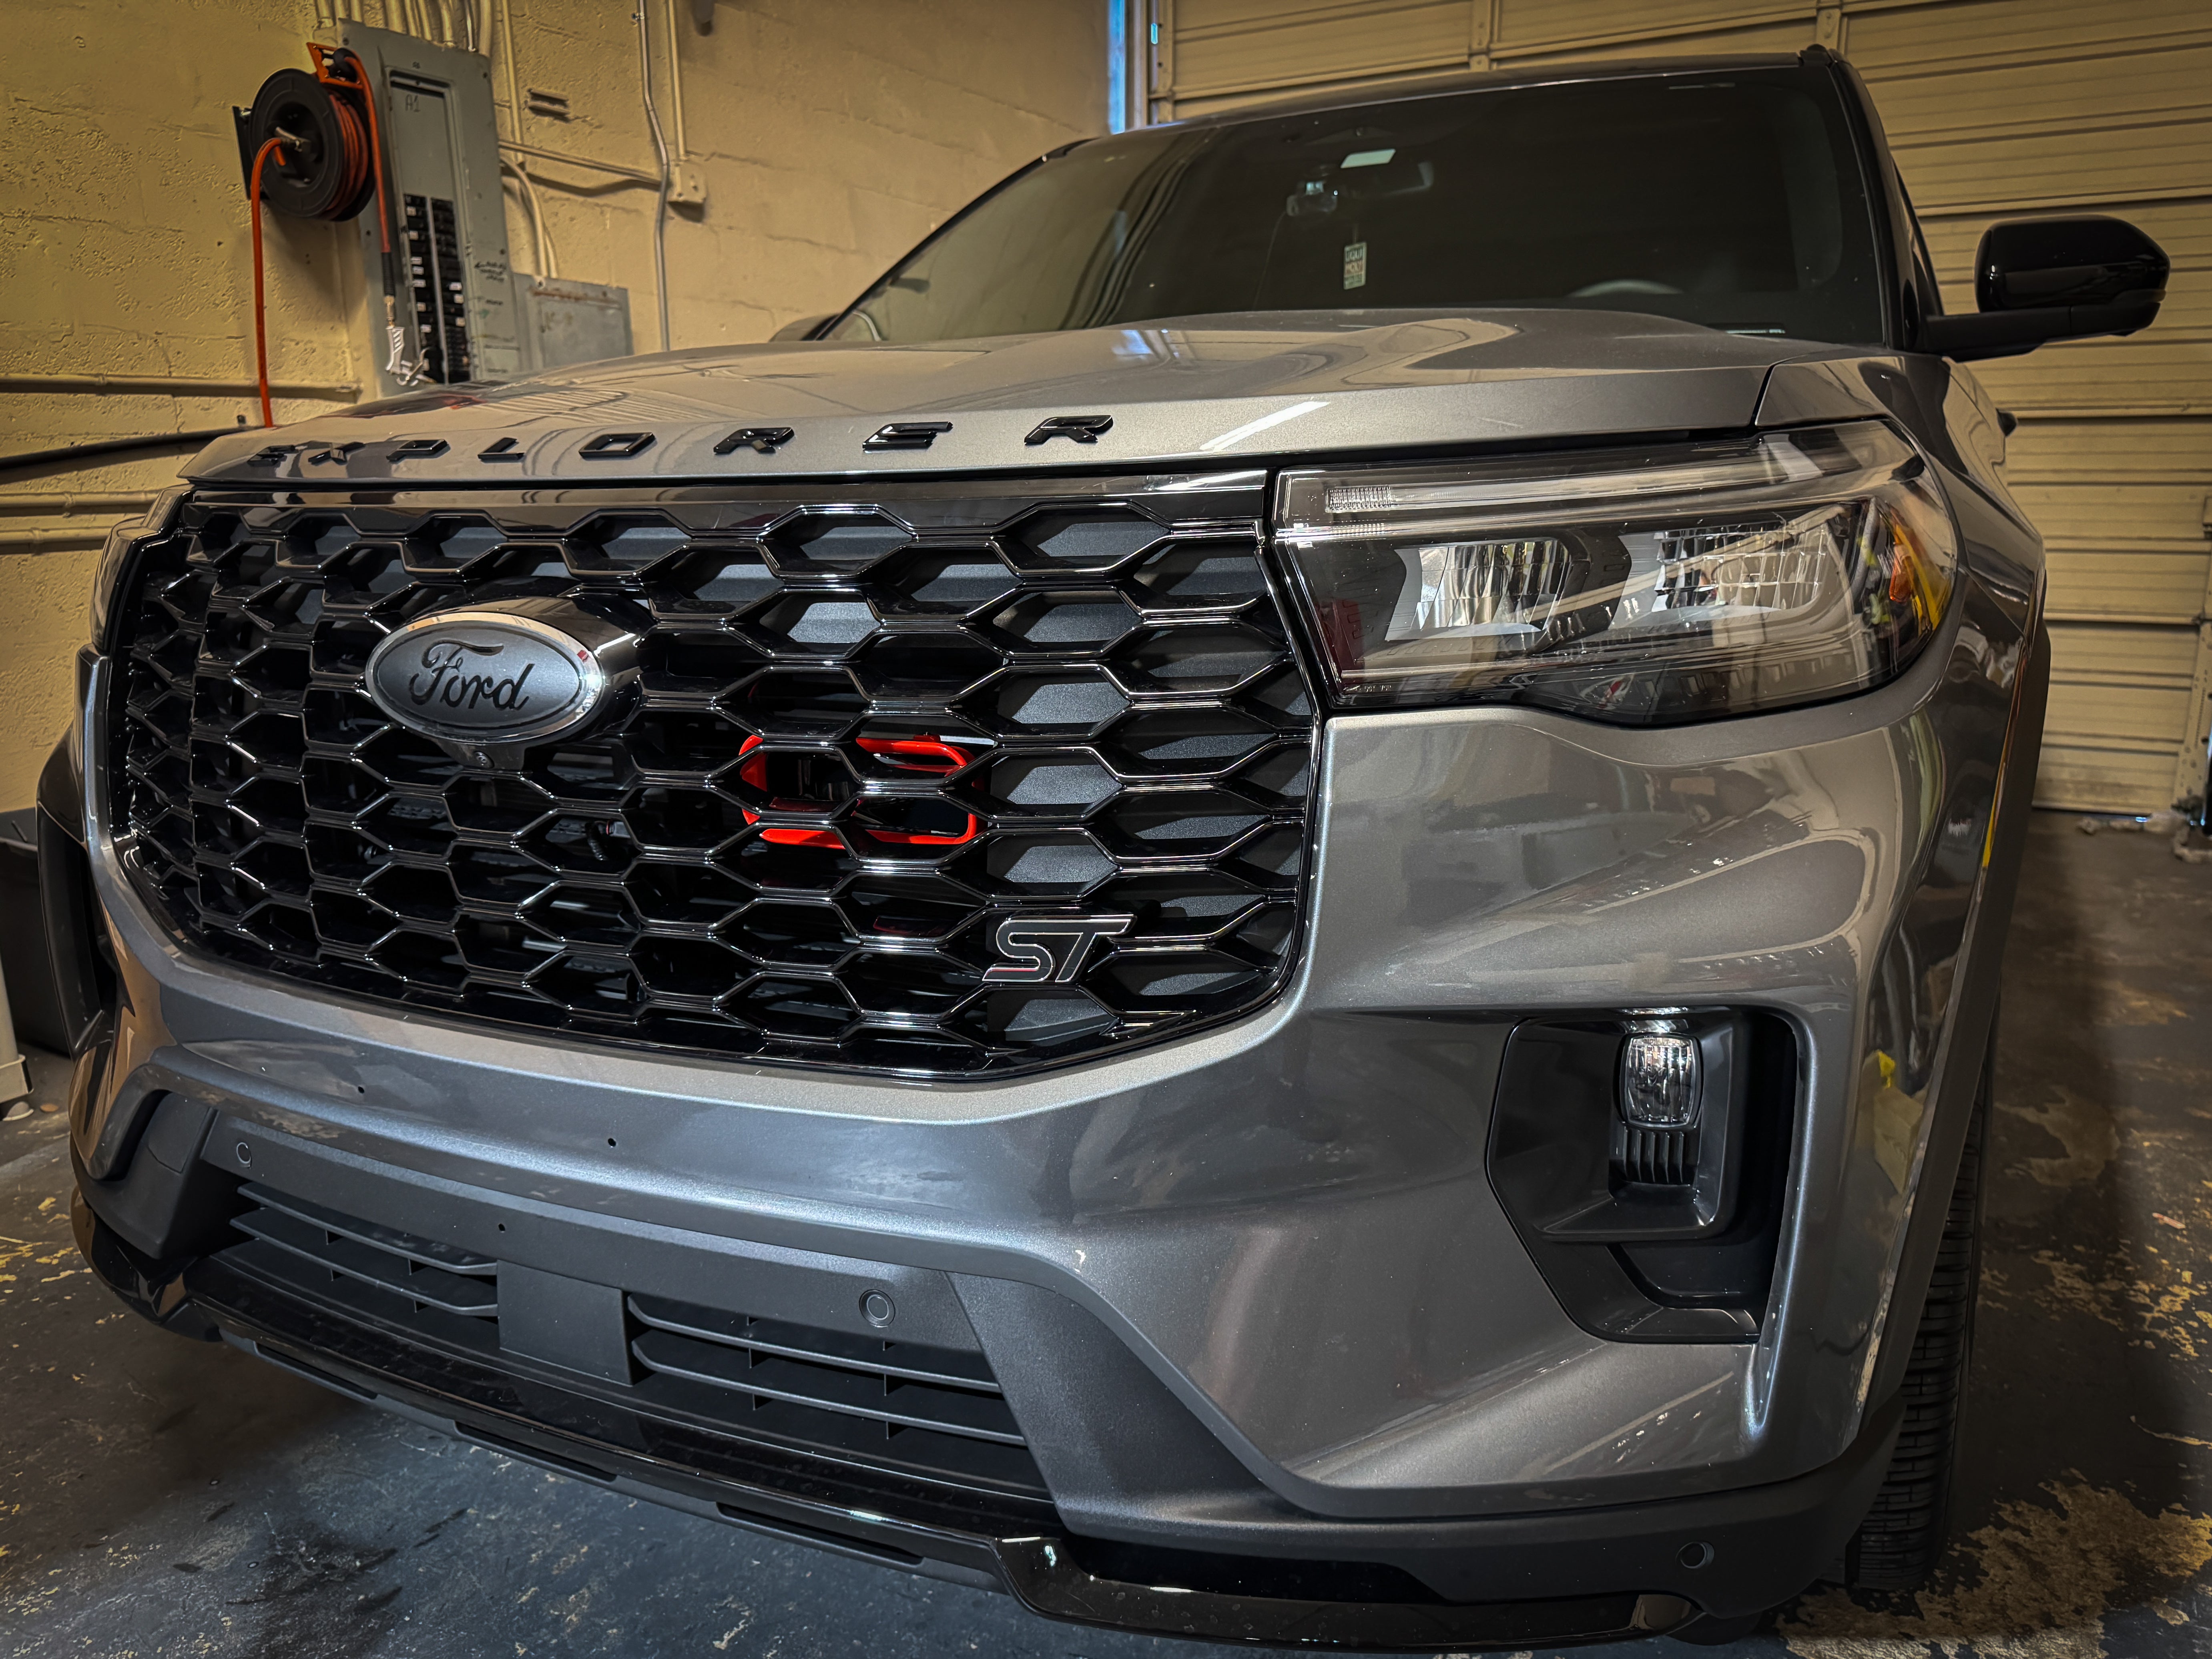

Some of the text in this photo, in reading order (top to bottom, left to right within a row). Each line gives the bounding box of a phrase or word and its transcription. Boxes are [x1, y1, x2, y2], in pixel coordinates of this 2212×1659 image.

[247, 415, 1114, 467] EXPLORER
[409, 639, 535, 711] Ford
[982, 915, 1134, 983] ST
